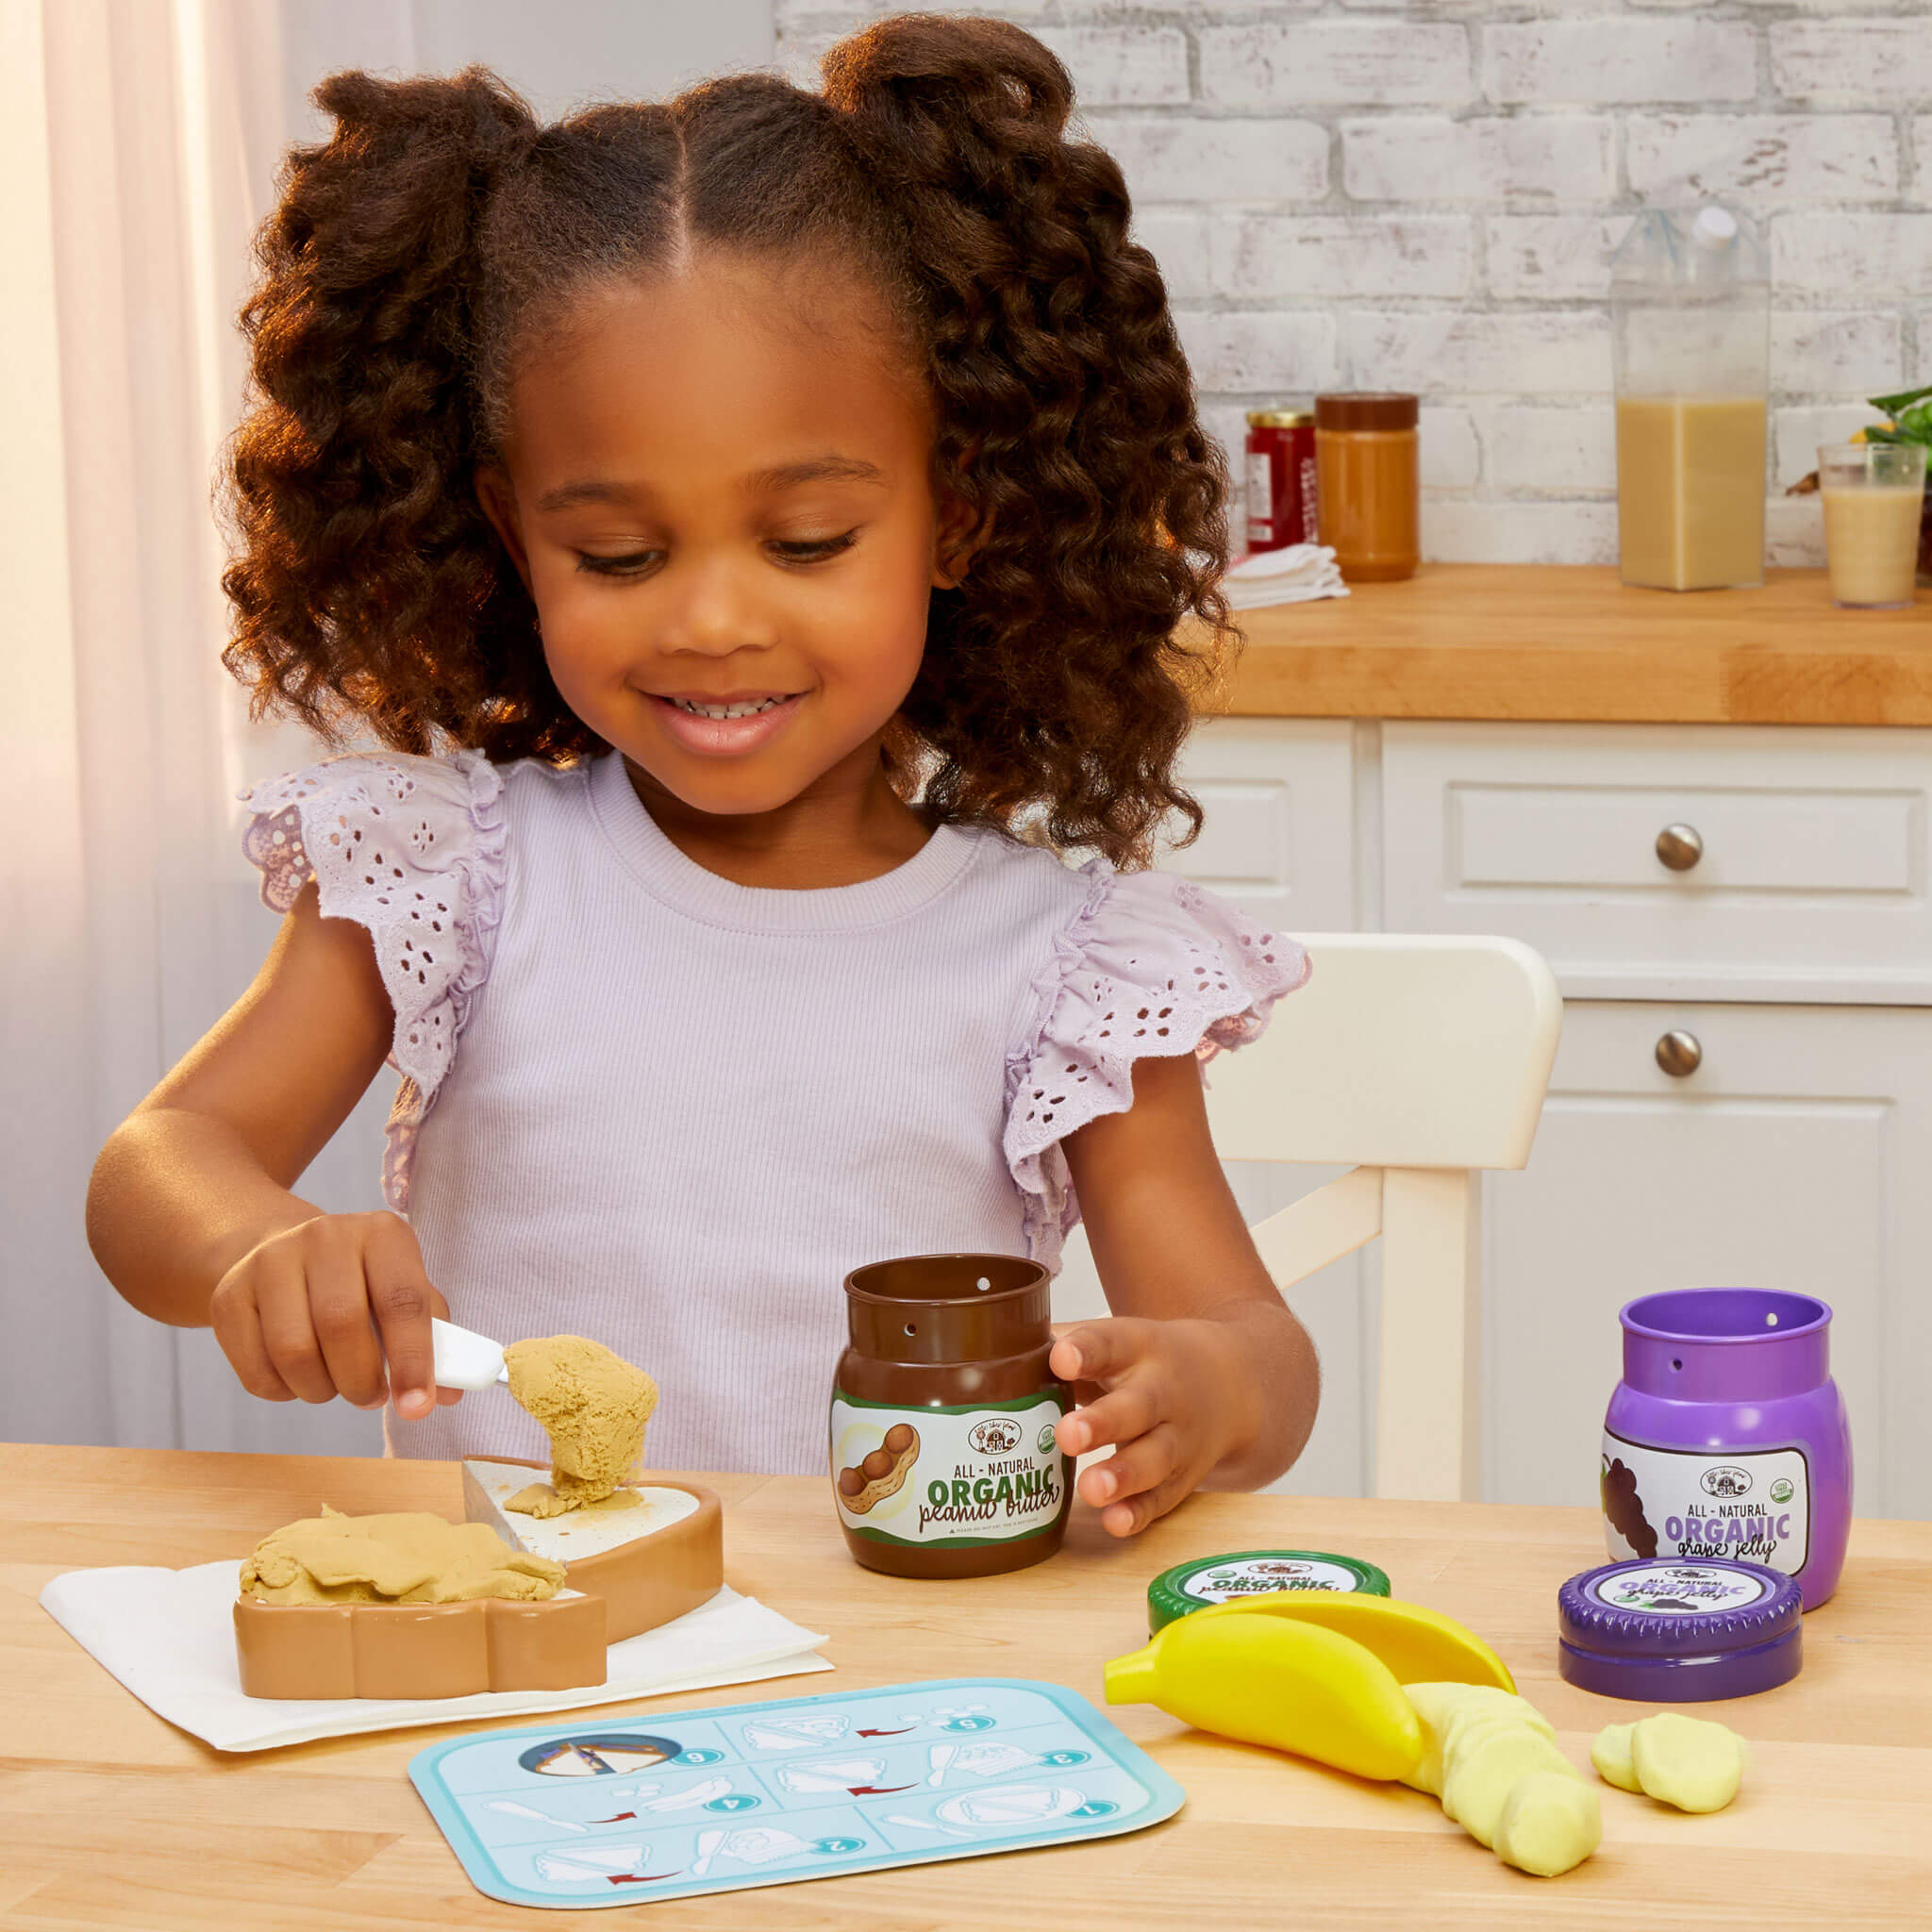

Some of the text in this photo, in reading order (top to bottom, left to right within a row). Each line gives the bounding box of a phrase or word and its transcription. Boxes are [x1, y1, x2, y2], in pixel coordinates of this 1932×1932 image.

[954, 1463, 975, 1479] ALL
[988, 1457, 1035, 1476] NATURAL
[927, 1464, 1055, 1507] ORGANIC
[919, 1486, 1060, 1533] peanut butter
[1688, 1504, 1707, 1517] ALL
[1719, 1504, 1768, 1517] NATURAL
[1665, 1513, 1790, 1543] ORGANIC
[1678, 1534, 1777, 1564] grape jelly
[1212, 1580, 1336, 1589] ORGANIC
[1620, 1582, 1747, 1594] ORGANIC
[1627, 1589, 1729, 1601] grape jelly
